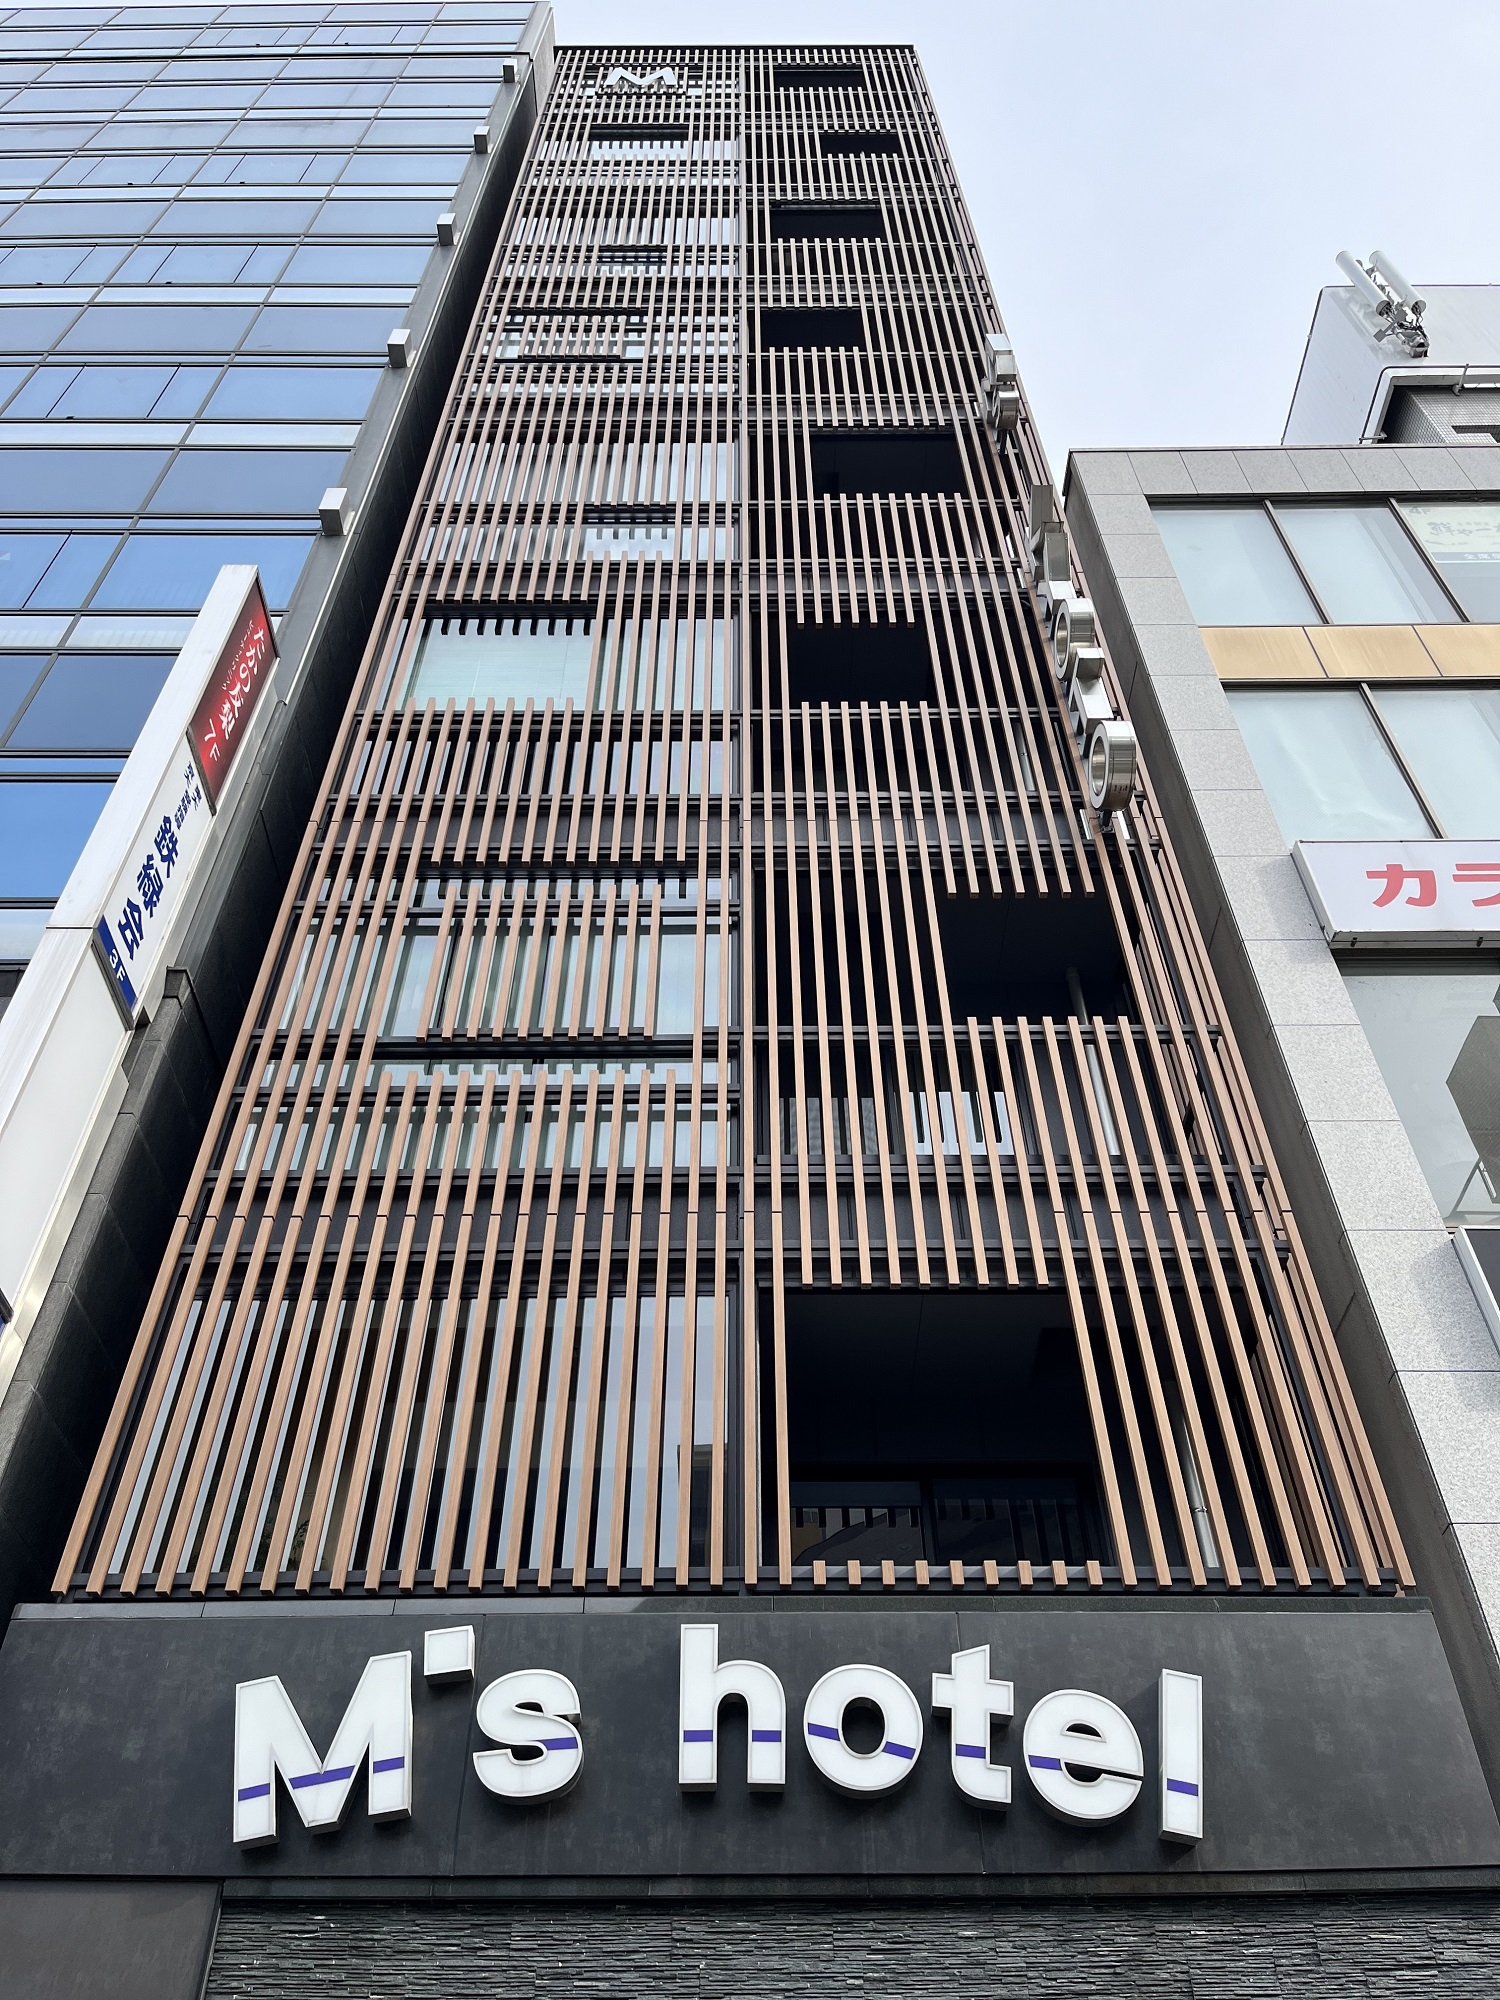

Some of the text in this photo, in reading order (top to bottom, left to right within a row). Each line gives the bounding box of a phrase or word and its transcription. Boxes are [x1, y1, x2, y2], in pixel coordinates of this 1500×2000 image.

[204, 718, 221, 762] 7F
[219, 626, 266, 741] たかの友梨
[117, 815, 179, 961] 鉄緑会
[109, 948, 126, 982] 3F
[232, 1622, 1204, 1846] M's hotel
